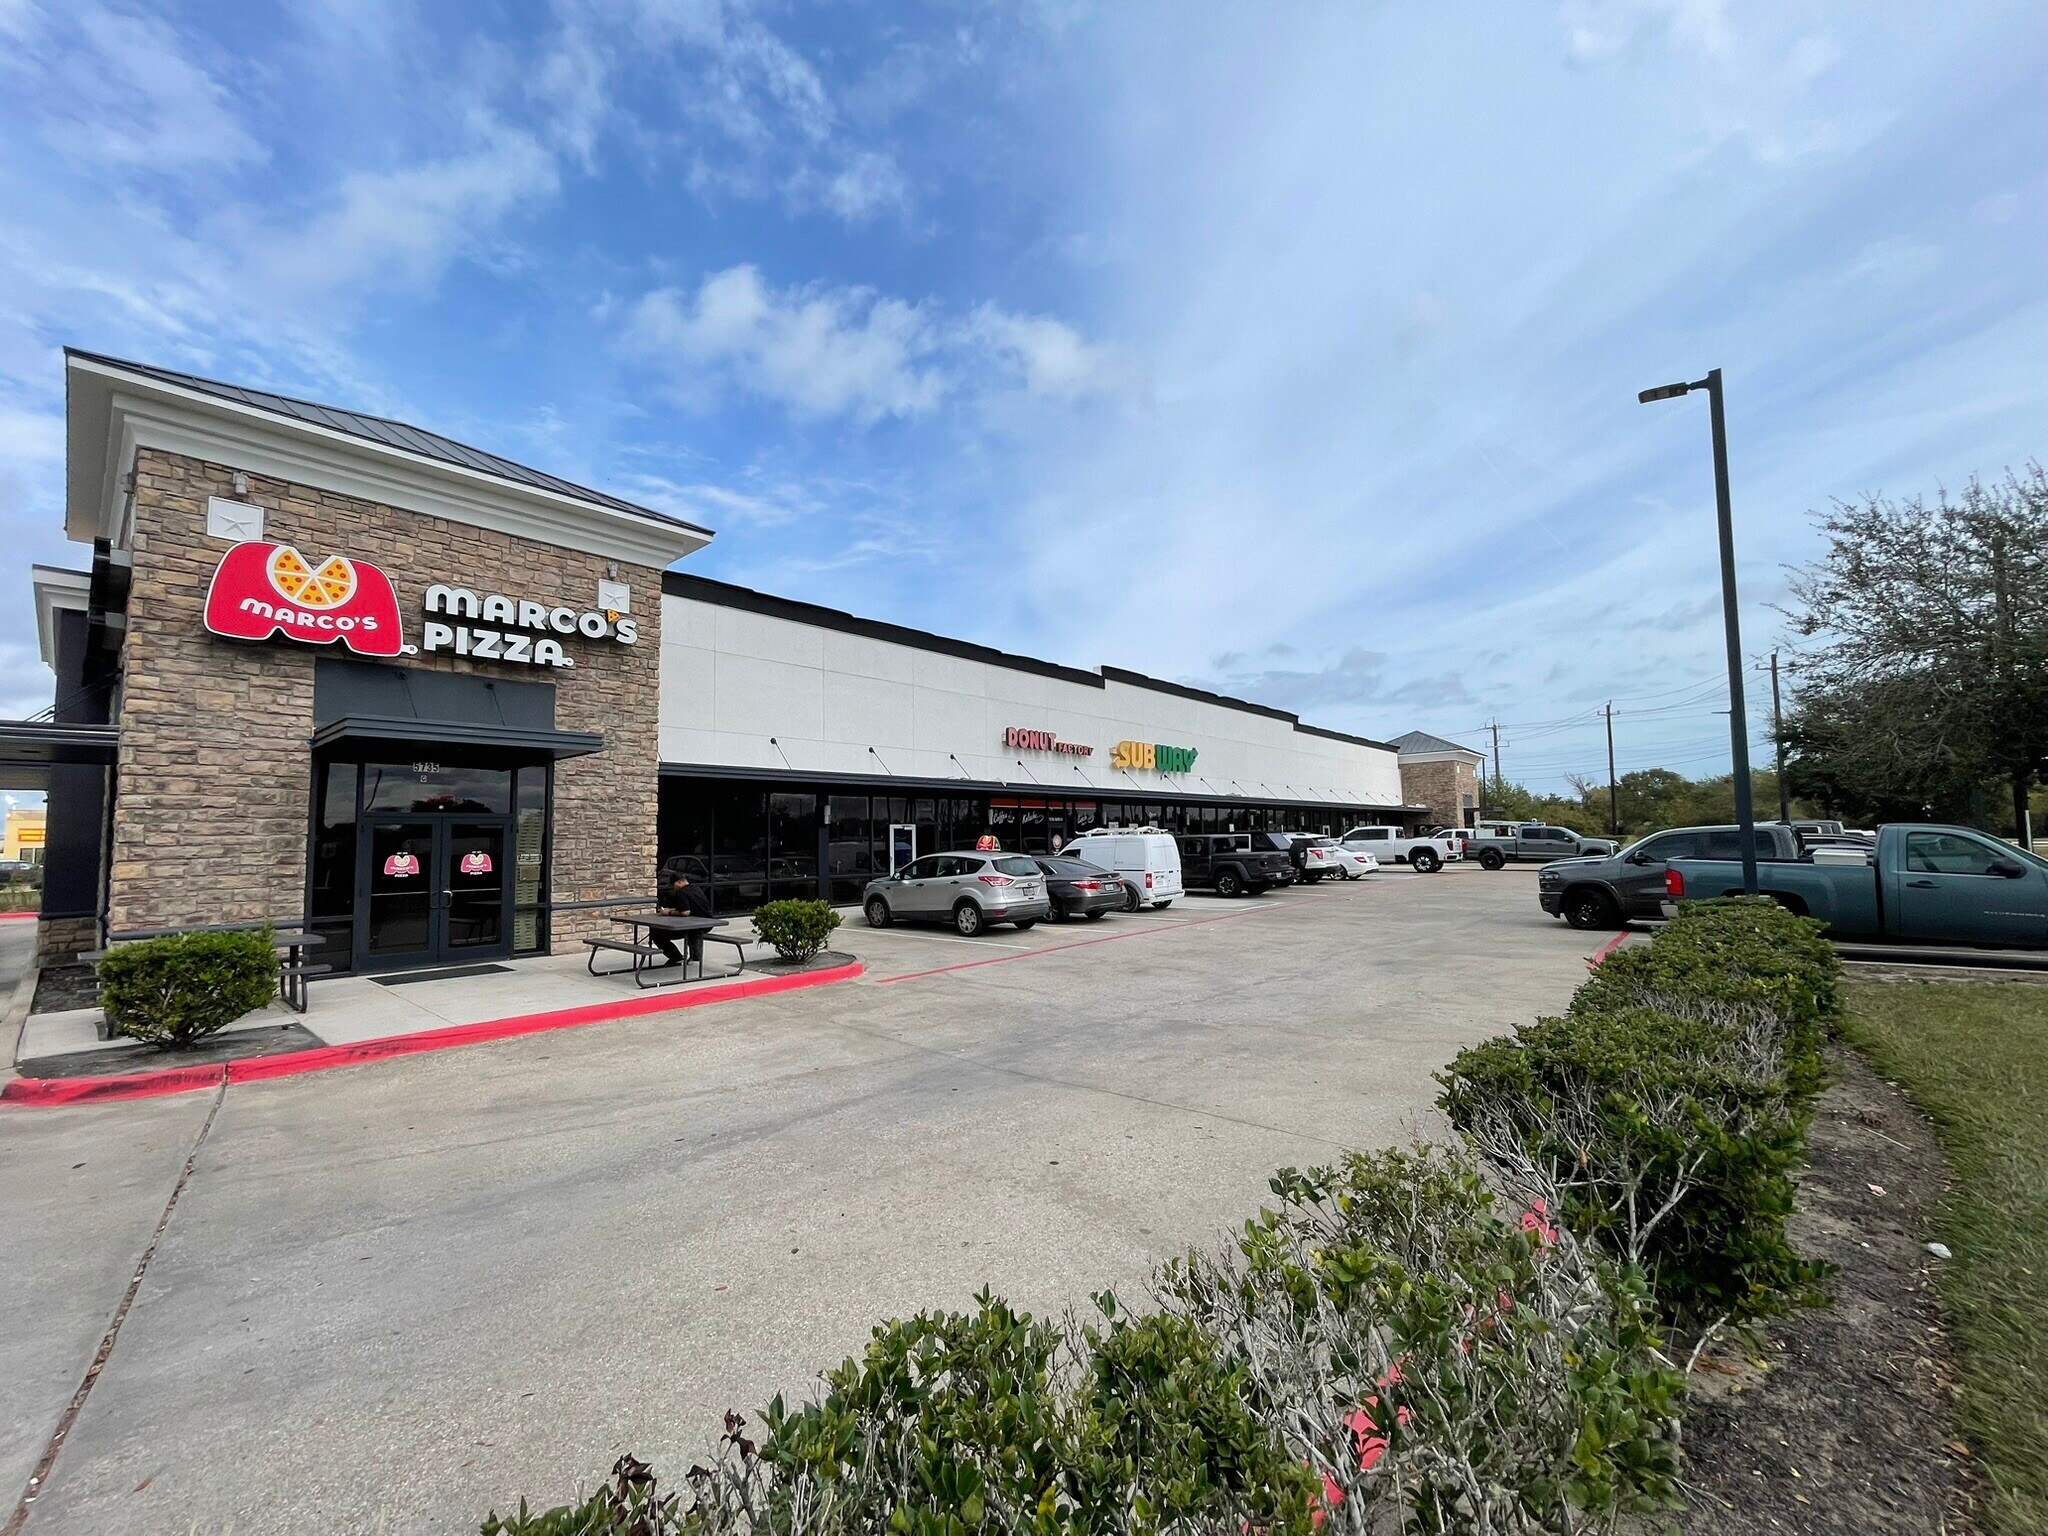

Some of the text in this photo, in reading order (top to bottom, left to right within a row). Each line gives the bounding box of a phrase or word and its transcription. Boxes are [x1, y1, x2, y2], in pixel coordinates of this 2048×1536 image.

[239, 597, 379, 631] MARCO'S
[424, 583, 639, 645] MARCO'S
[423, 621, 566, 667] PIZZA
[1006, 726, 1095, 757] DONUT FACTORY
[1109, 740, 1200, 773] SUBWAY
[412, 762, 440, 773] 5735
